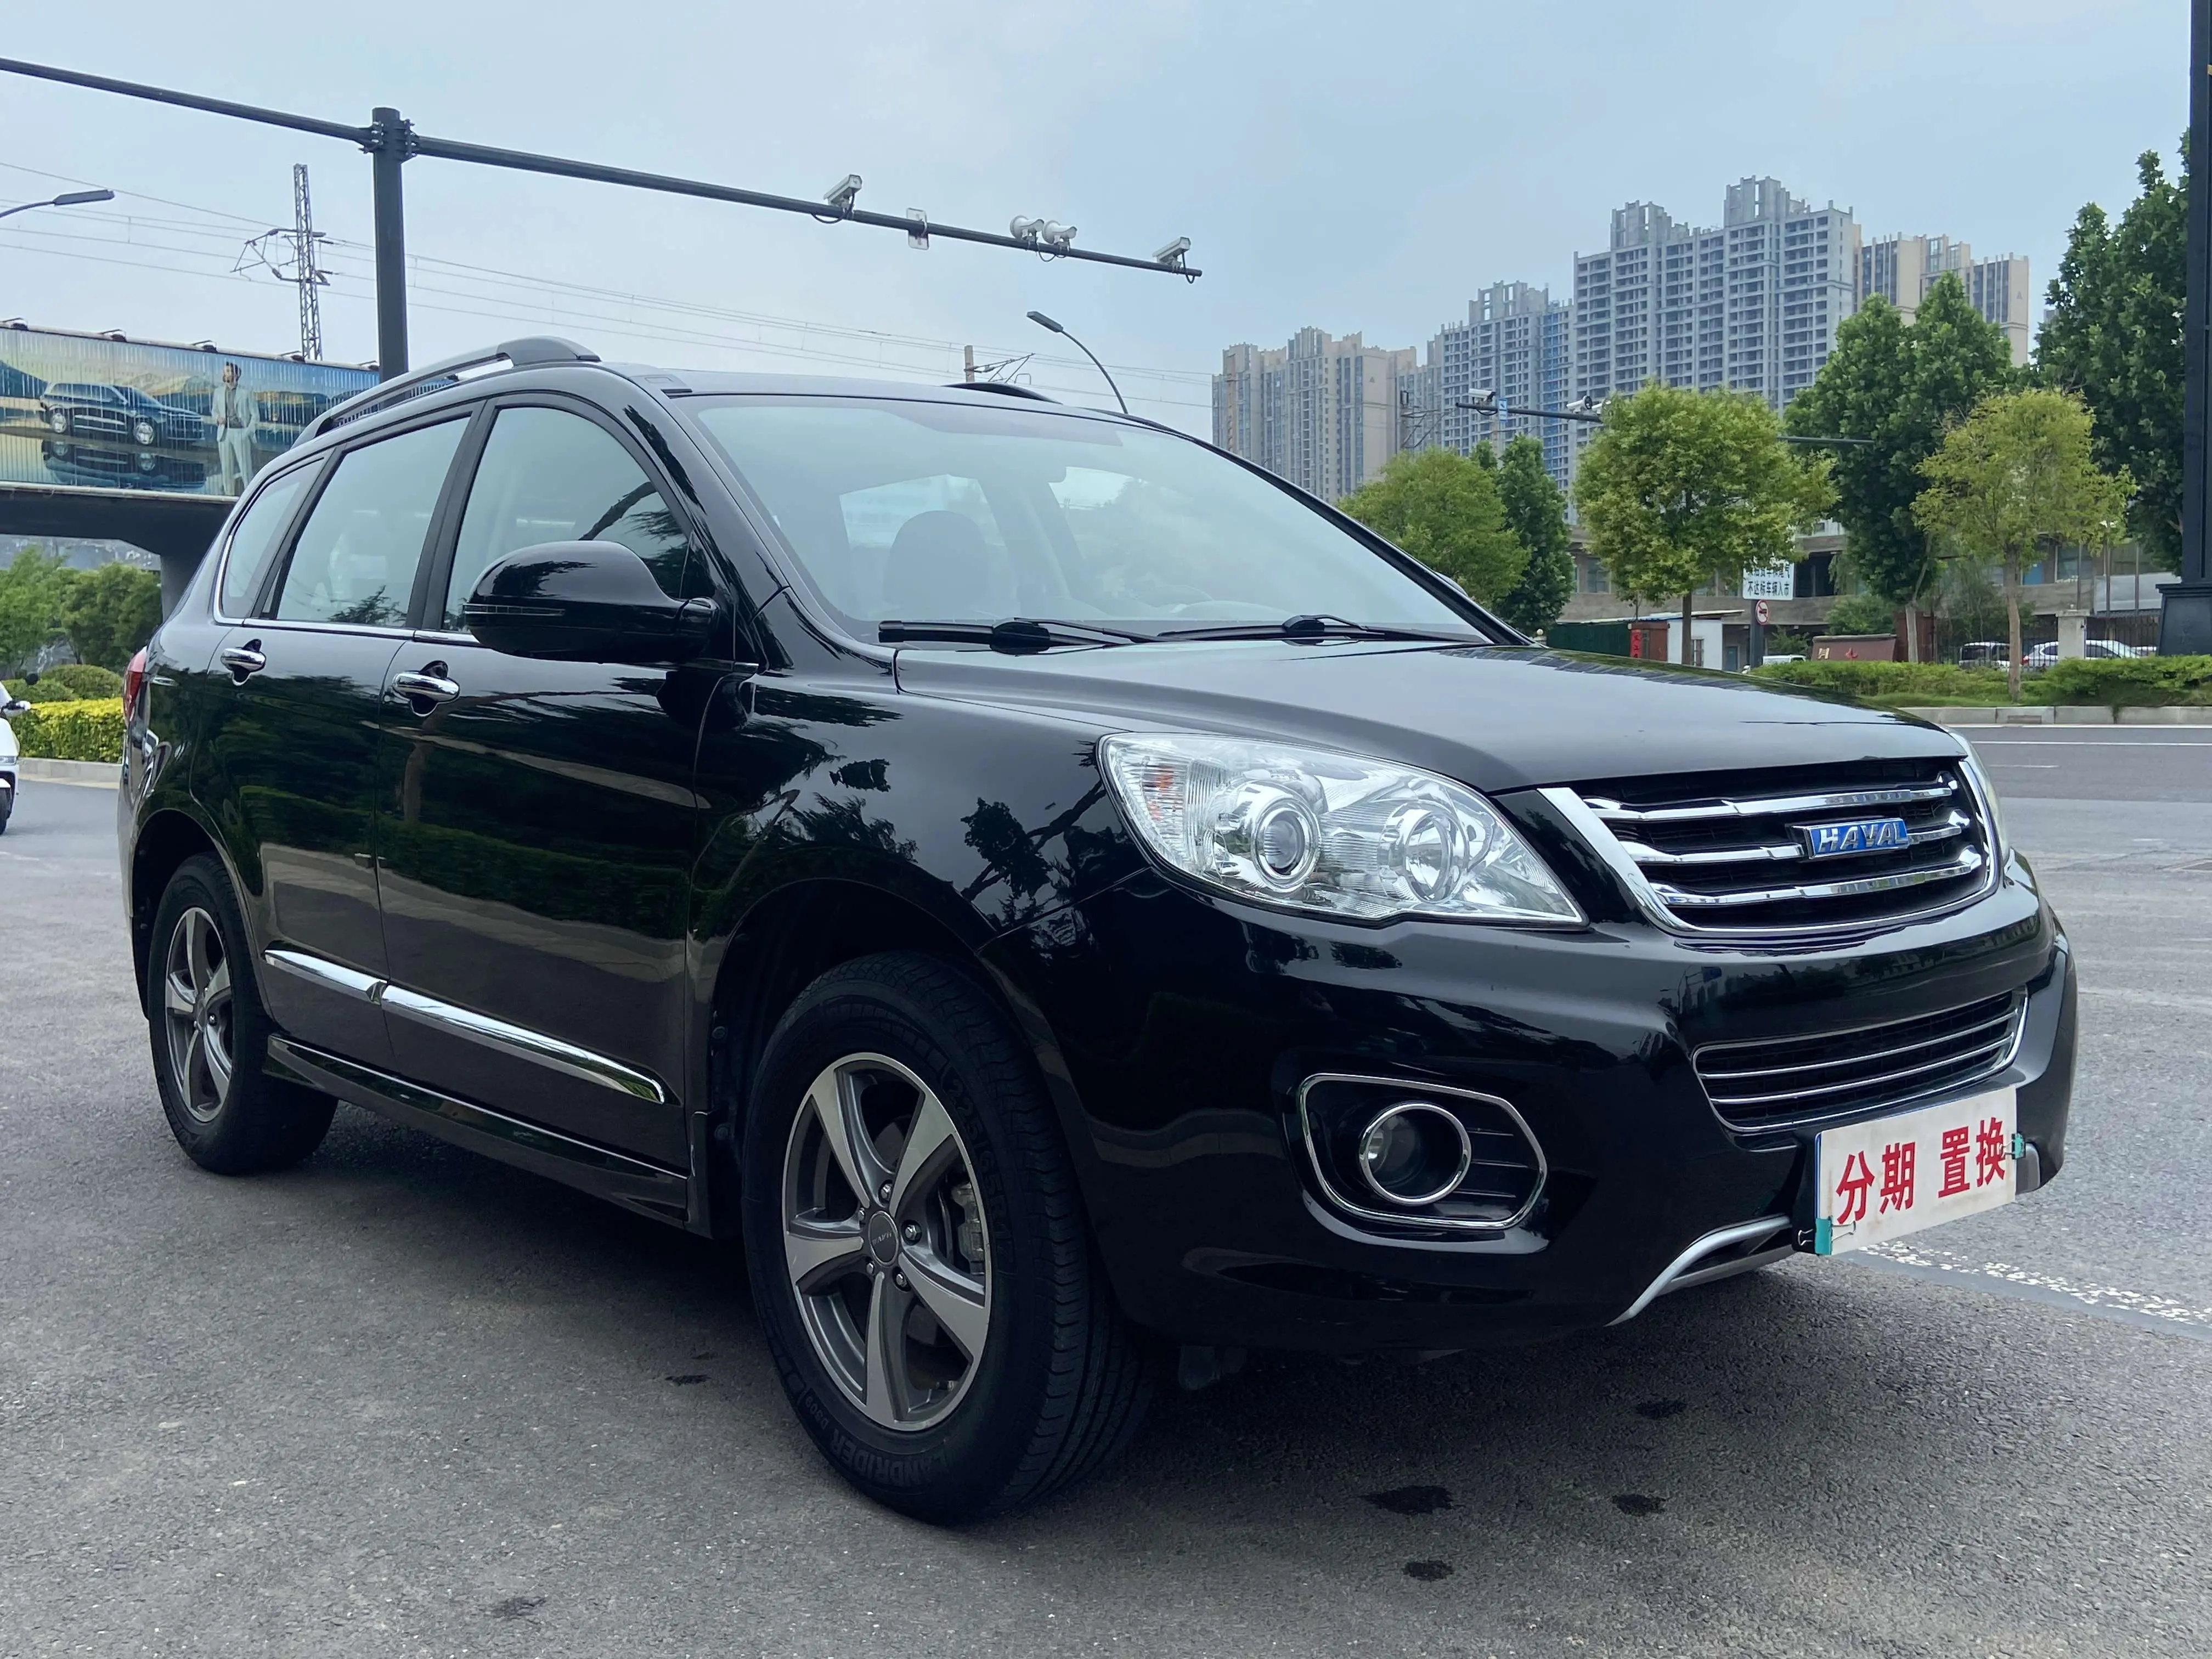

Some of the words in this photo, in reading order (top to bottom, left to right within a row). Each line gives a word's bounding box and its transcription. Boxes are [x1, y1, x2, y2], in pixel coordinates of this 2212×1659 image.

[1747, 581, 1790, 596] 不达标车辆入市
[1819, 823, 1908, 852] HAVAL
[1836, 1142, 1915, 1224] 分期
[1938, 1117, 2005, 1198] 置换
